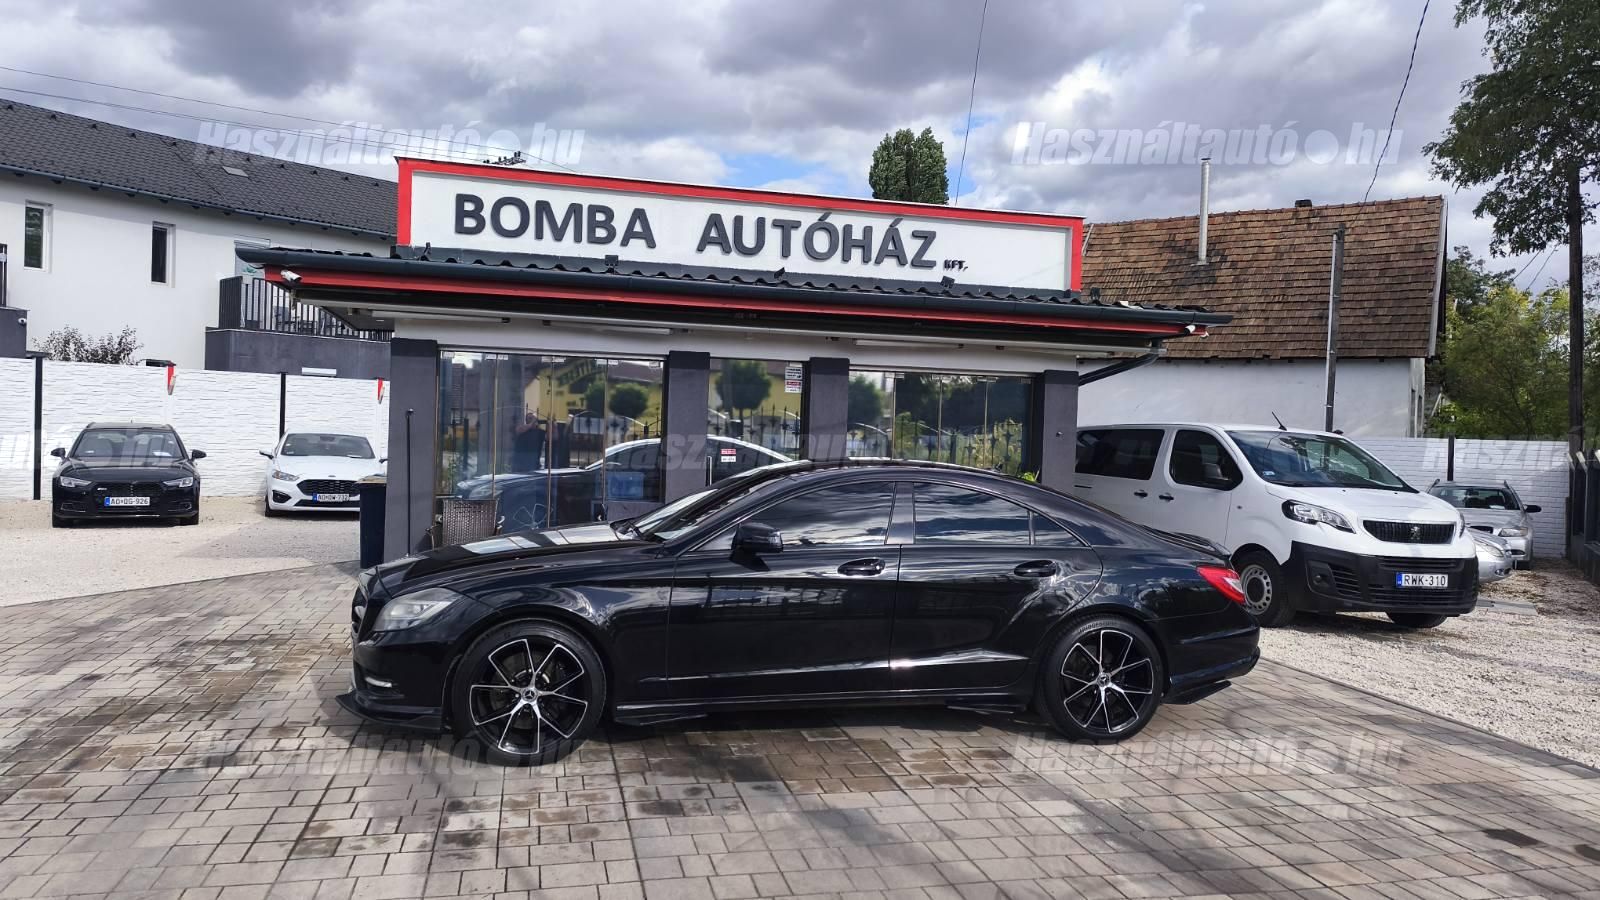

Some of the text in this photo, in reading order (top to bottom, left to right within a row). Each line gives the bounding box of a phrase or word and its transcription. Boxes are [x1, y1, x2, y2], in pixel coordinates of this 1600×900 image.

[454, 193, 656, 248] BOMBA
[697, 212, 937, 268] AUTÓHÁZ
[1404, 575, 1446, 586] RWK-310
